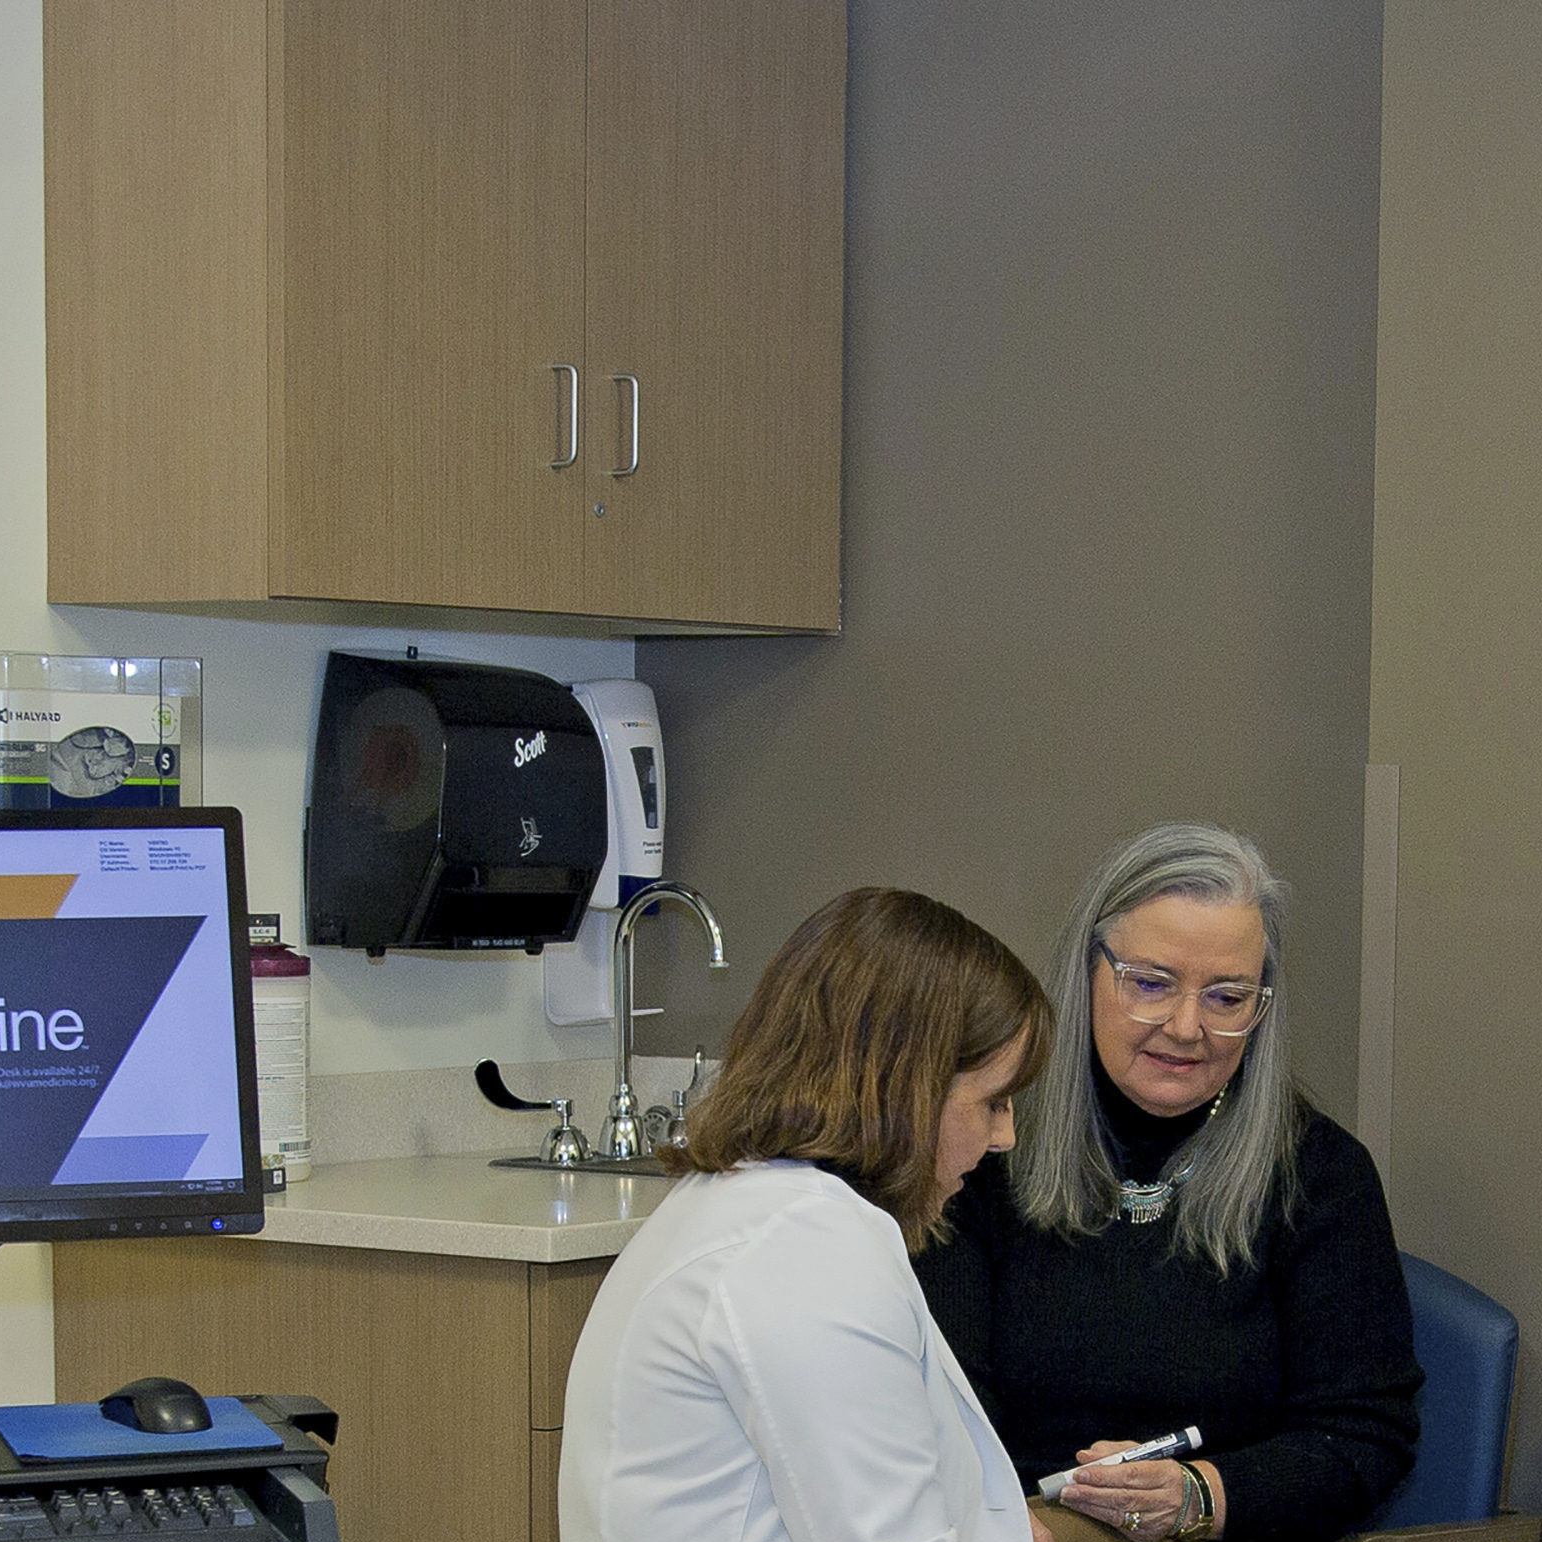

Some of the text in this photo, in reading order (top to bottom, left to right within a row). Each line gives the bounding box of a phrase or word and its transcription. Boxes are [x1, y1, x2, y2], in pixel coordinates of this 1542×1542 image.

[15, 711, 61, 722] HALYARD
[514, 730, 546, 767] Scott
[162, 753, 170, 770] S
[23, 1066, 31, 1076] is
[32, 1065, 76, 1076] available
